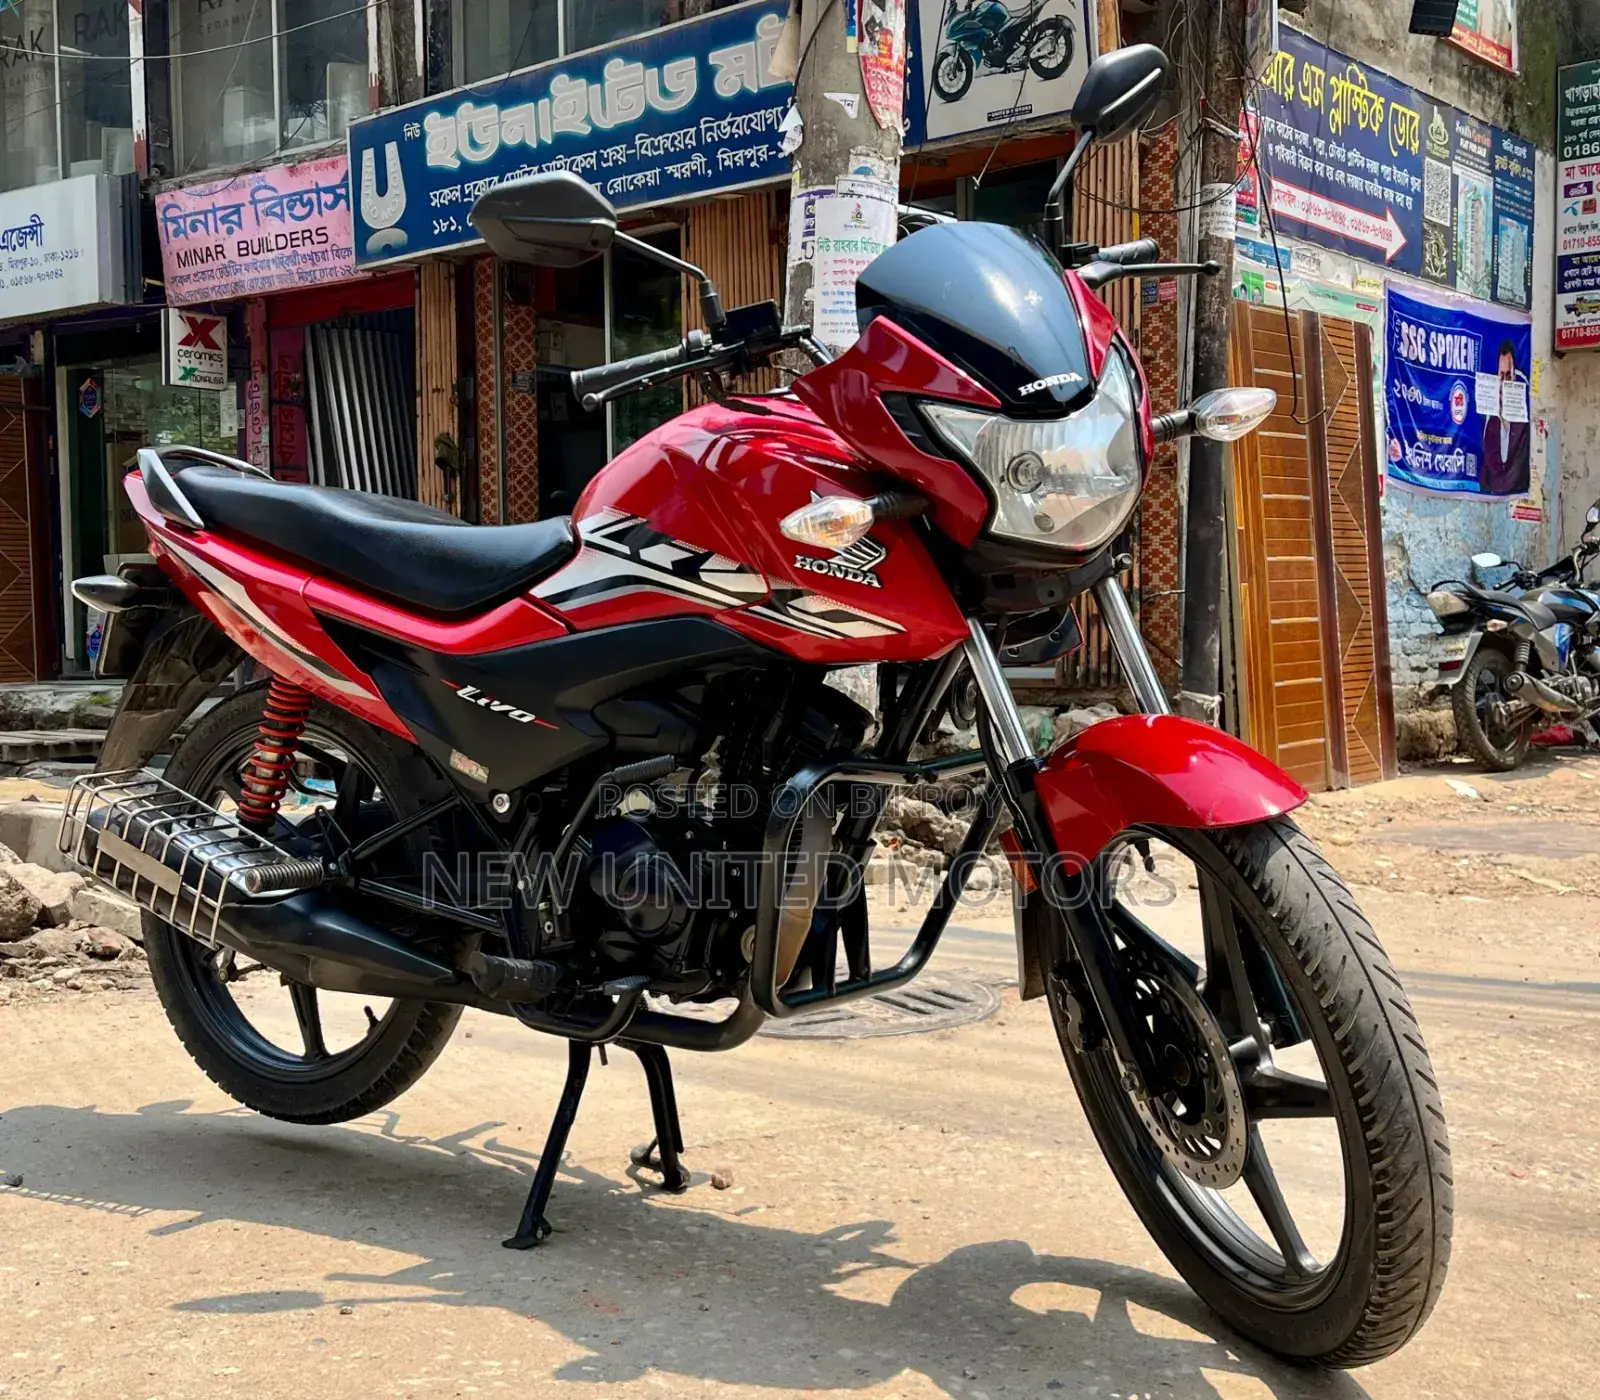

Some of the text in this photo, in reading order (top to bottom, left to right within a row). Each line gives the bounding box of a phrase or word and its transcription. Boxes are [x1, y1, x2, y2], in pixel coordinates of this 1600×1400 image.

[2, 69, 50, 91] ERAMICS
[424, 57, 698, 169] ইউনাইটেড
[708, 13, 796, 98] মট
[1564, 79, 1600, 103] খাগড়াছ
[1261, 50, 1421, 157] আর এম প্লাস্টিক ডোর
[403, 121, 421, 142] নিউ
[429, 184, 461, 208] সকল
[600, 126, 697, 167] ক্রয়-বিক্রয়ের
[700, 105, 784, 146] নির্ভরযোগ্য
[607, 166, 661, 196] রোকেয়া
[665, 152, 713, 179] স্মরণী,
[1564, 161, 1600, 180] মা আয়ে
[364, 156, 379, 220] UNITED
[160, 202, 246, 245] মিনার
[432, 215, 463, 236] ১৮১,
[176, 226, 330, 269] MINAR BUILDERS
[816, 236, 831, 253] নিউ
[833, 238, 859, 254] রাহবার
[177, 348, 224, 363] ceramics
[1400, 320, 1427, 364] SSC
[1429, 333, 1475, 372] SPOKEN
[1017, 371, 1084, 397] HONDA
[793, 554, 882, 589] HONDA
